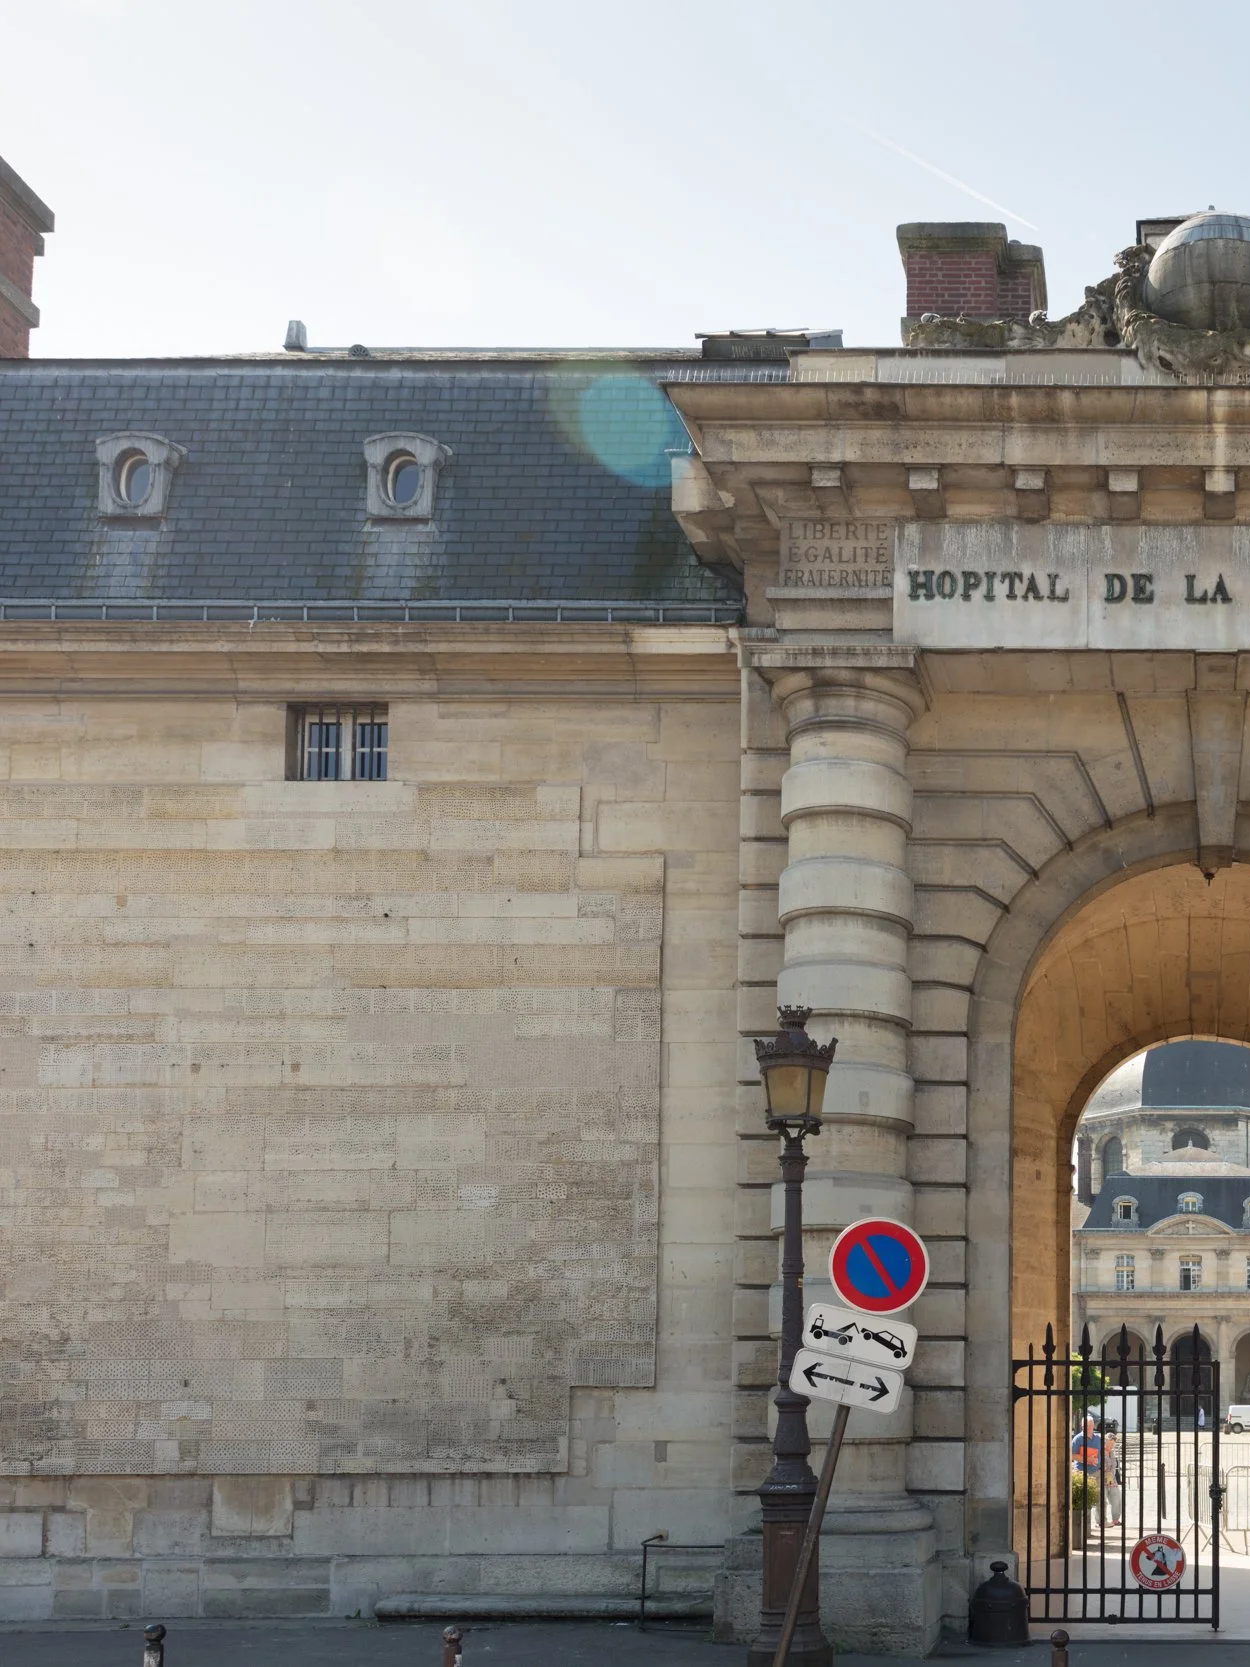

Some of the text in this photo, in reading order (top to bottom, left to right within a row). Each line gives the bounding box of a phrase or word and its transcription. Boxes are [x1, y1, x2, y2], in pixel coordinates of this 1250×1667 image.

[788, 542, 888, 563] ÉGALITÉ
[784, 566, 892, 587] FRATERNITÉ
[907, 569, 1070, 602] HOPITAL
[1104, 573, 1155, 603] DE
[1185, 573, 1232, 604] LA
[1136, 1571, 1153, 1587] TENUS
[1163, 1571, 1181, 1587] LAISSE
